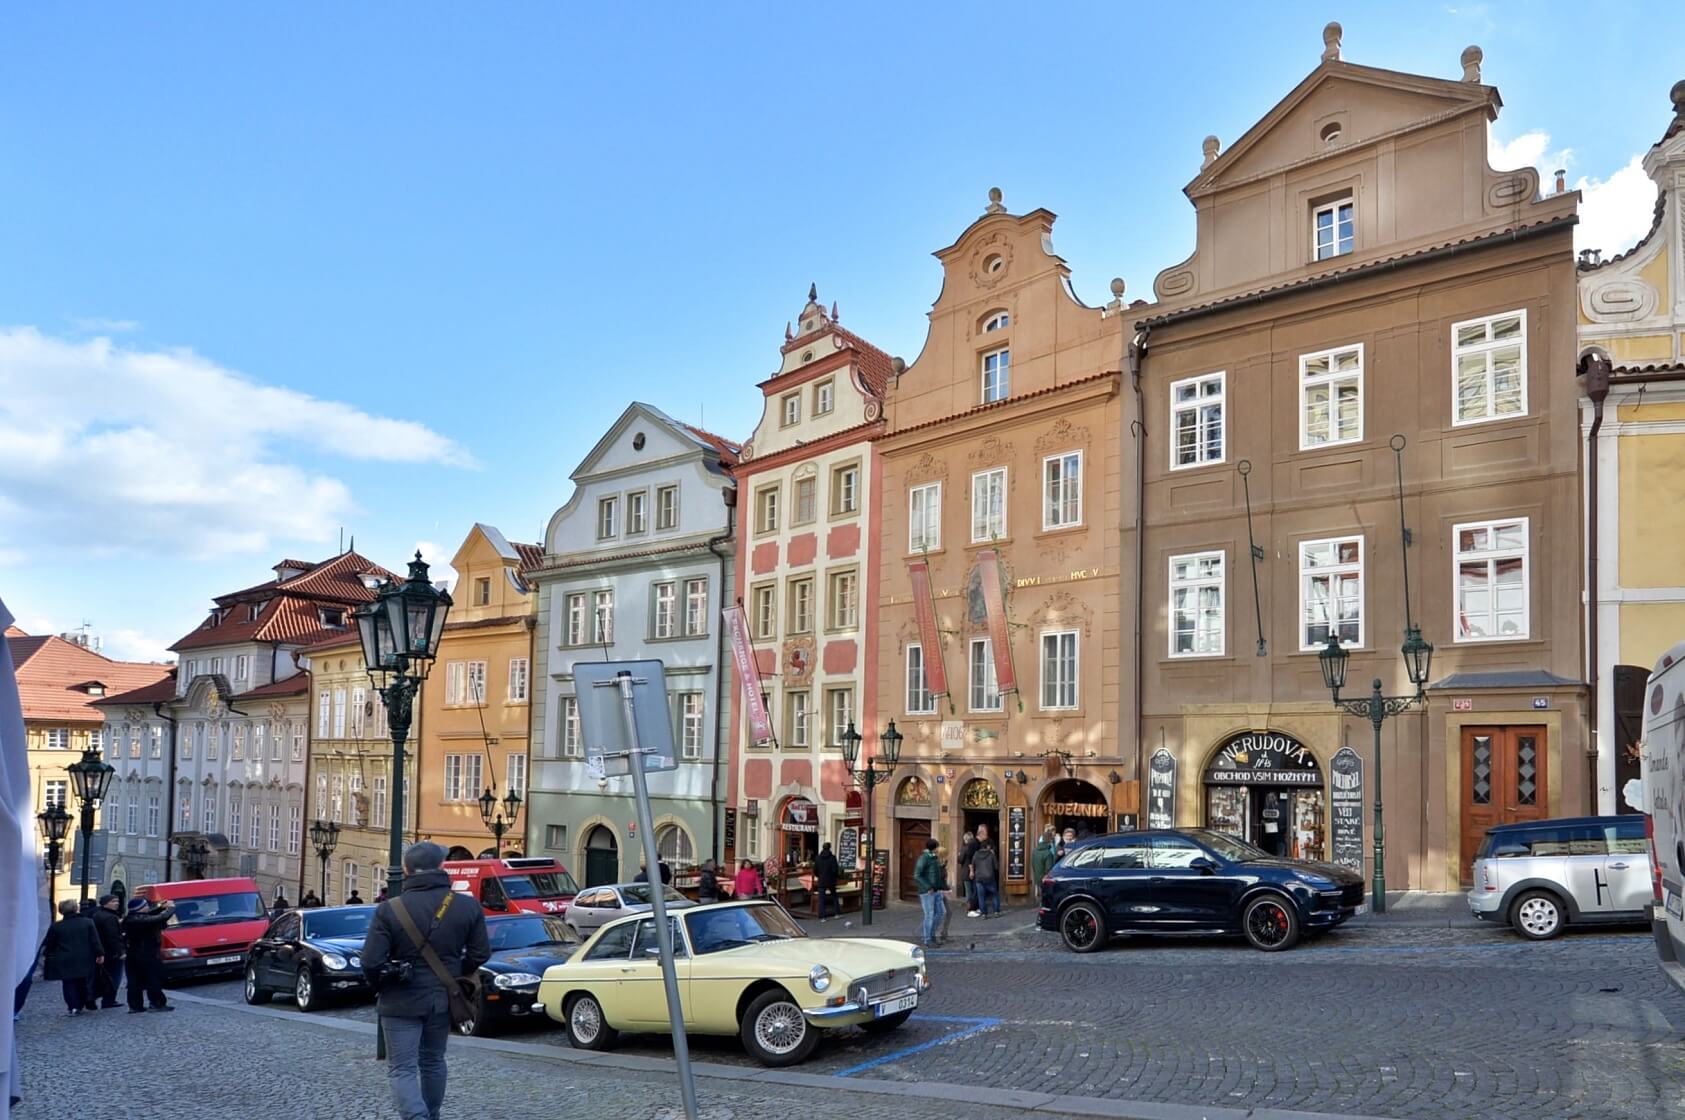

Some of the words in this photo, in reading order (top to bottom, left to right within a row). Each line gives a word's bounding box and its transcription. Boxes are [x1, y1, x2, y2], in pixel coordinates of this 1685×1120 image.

[1534, 698, 1547, 708] 45
[1222, 735, 1306, 765] NERUDOVA
[1213, 771, 1251, 781] OBCHOD
